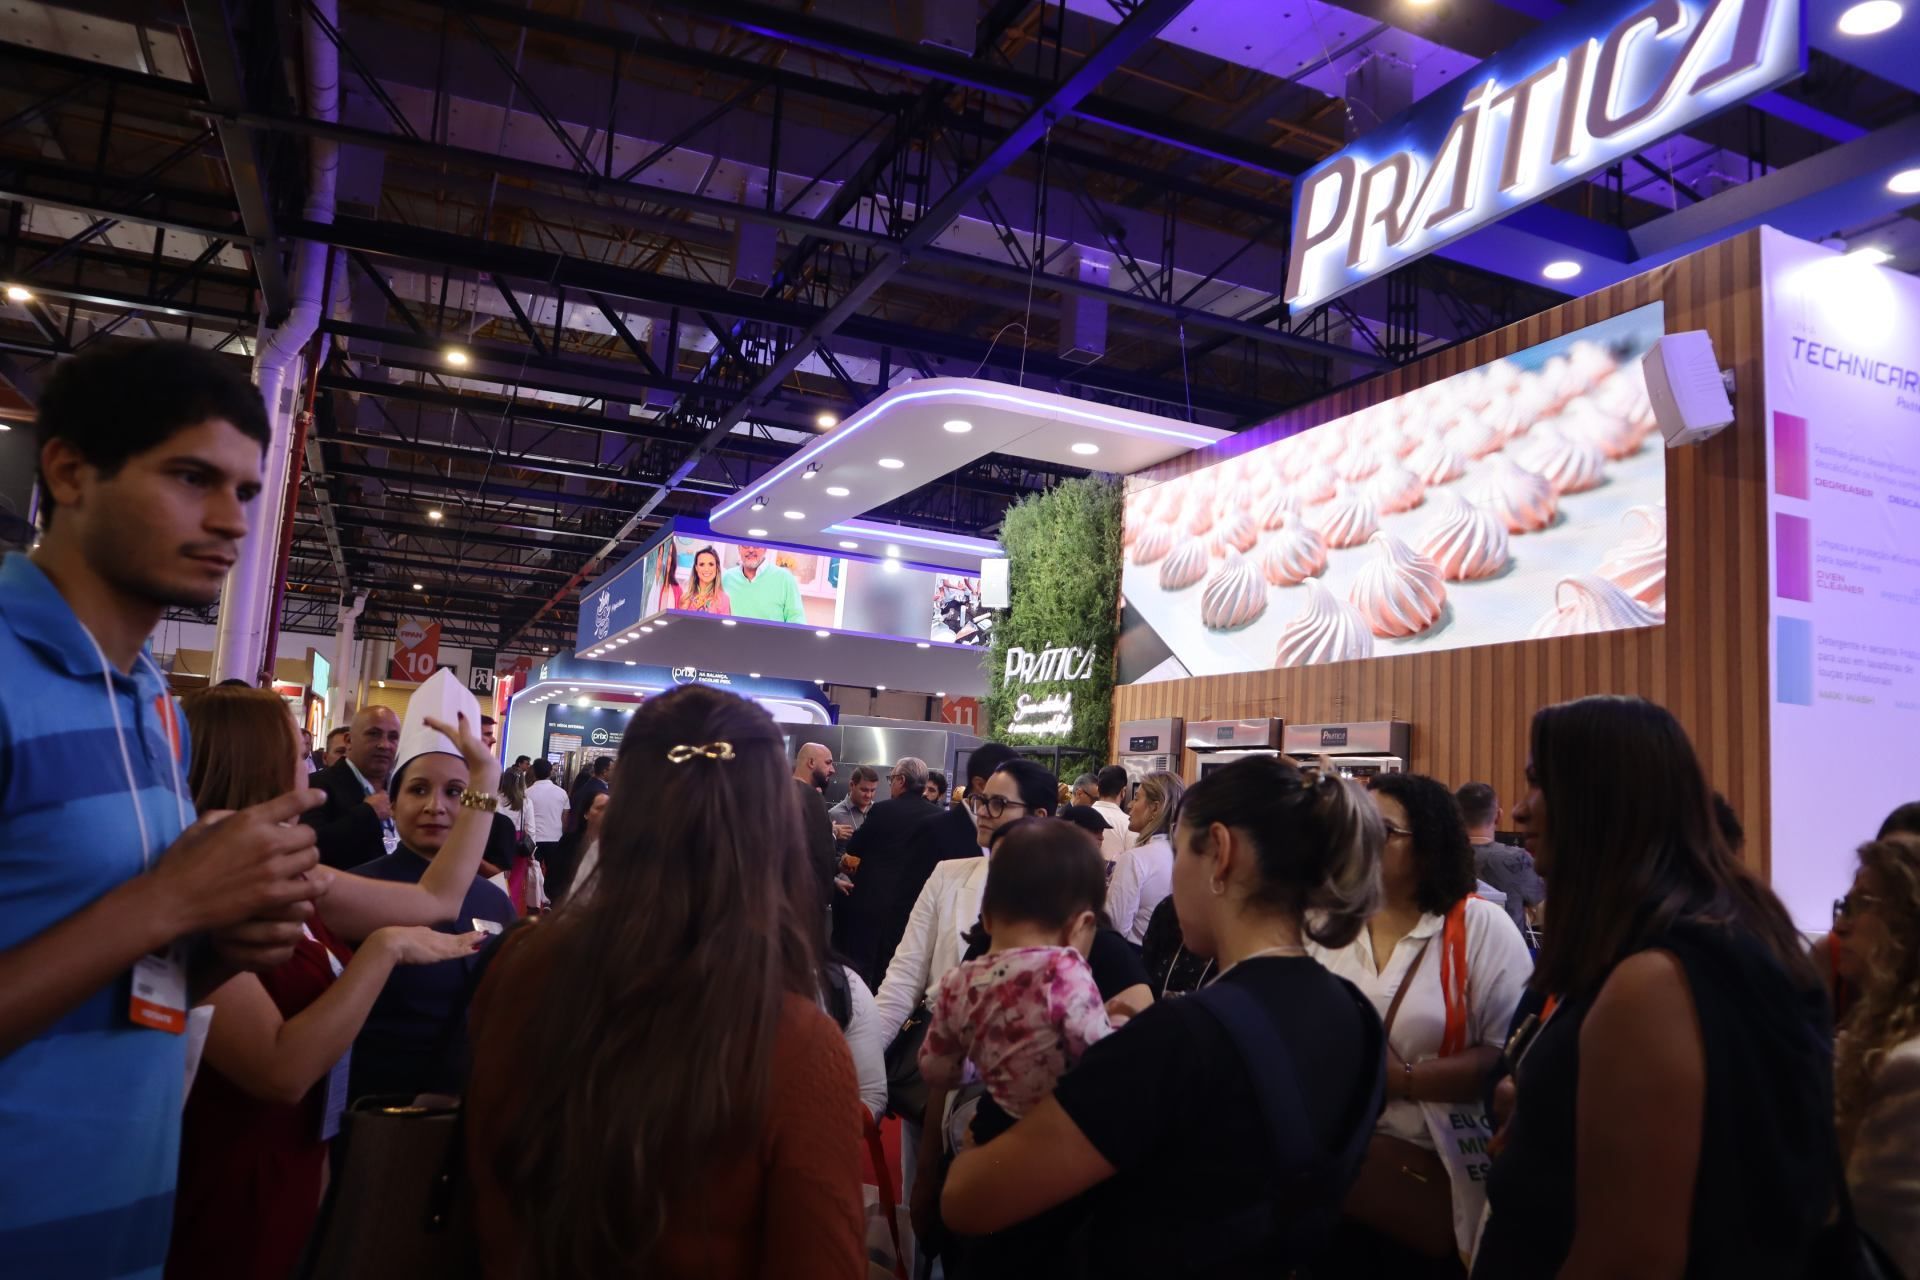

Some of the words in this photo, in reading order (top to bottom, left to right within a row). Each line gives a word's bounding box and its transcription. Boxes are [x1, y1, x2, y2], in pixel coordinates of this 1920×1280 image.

[1285, 0, 1776, 304] PRÁTICA
[1791, 335, 1920, 393] TECHNICAR
[1815, 477, 1874, 497] DEGREASER
[1816, 570, 1845, 583] OVEN
[1816, 579, 1865, 596] CLEANER
[407, 652, 434, 675] 10
[1003, 640, 1097, 688] PRÁTICA
[953, 705, 973, 726] 11
[1449, 1112, 1477, 1130] EU
